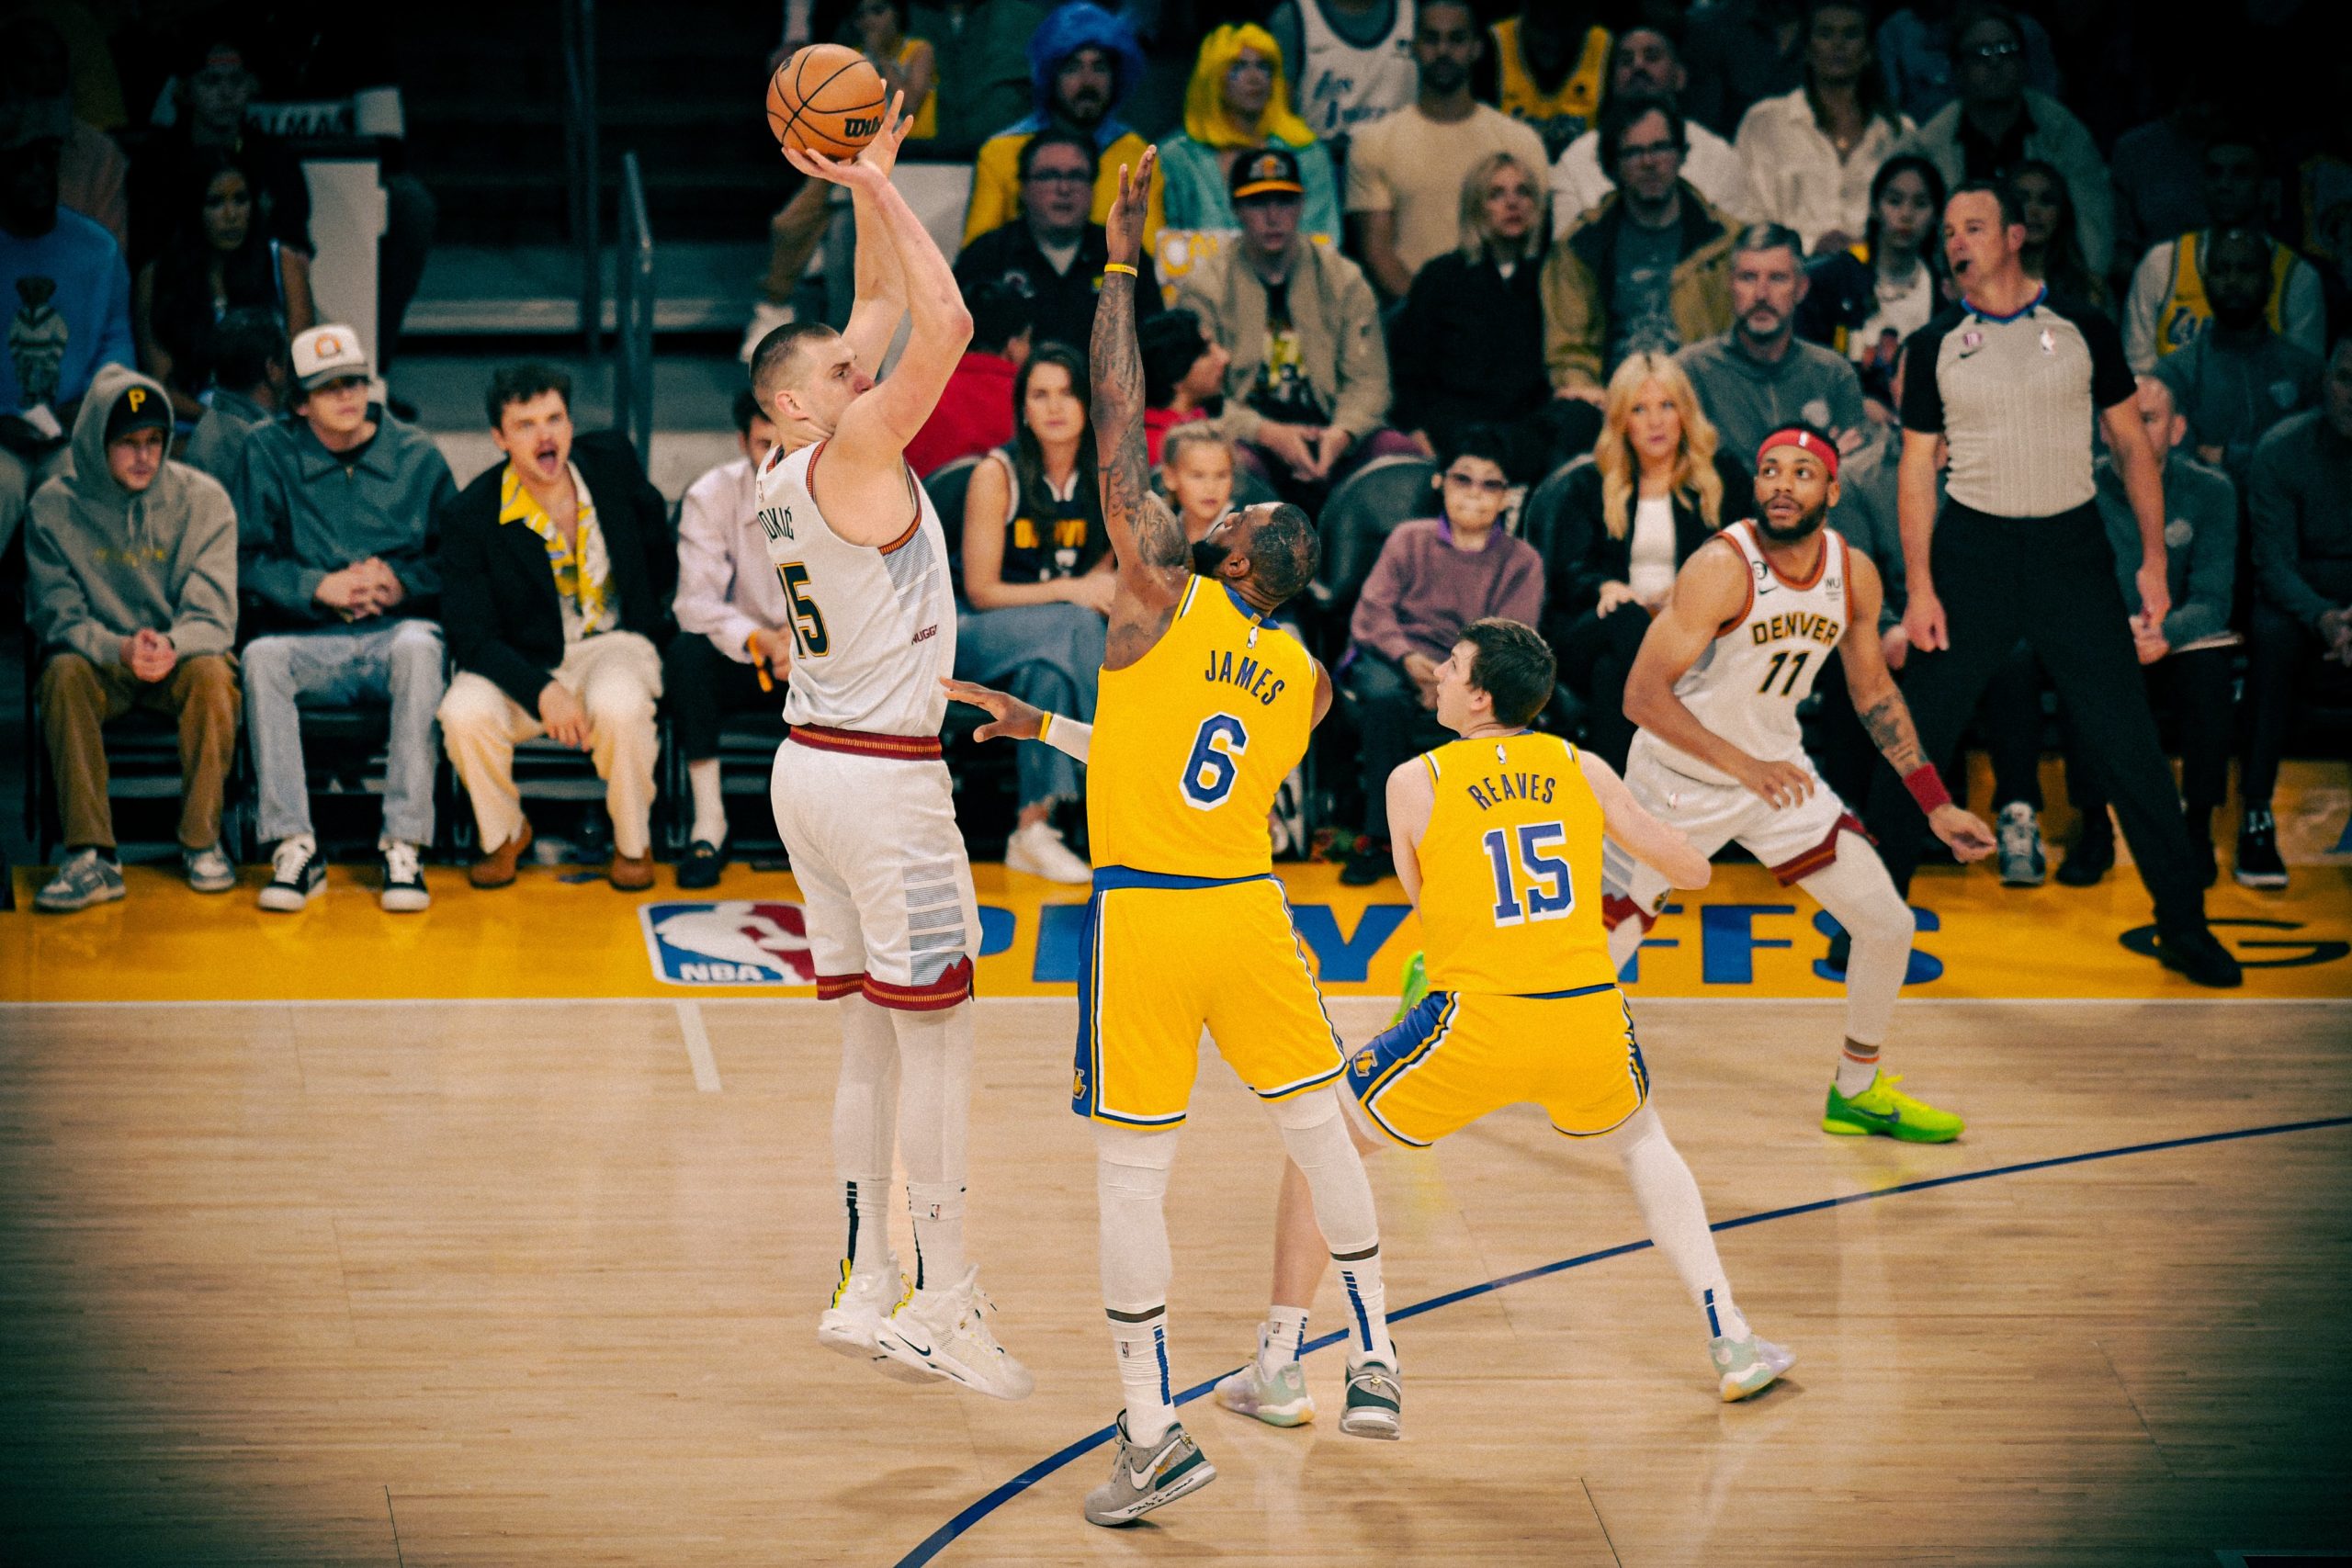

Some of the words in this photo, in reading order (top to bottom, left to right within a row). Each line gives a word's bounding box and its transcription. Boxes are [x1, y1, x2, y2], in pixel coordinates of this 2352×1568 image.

[128, 388, 147, 413] P
[757, 506, 794, 544] OKIĆ
[1750, 611, 1839, 647] DENVER
[1204, 649, 1284, 705] JAMES
[1757, 650, 1811, 696] 11
[1179, 711, 1250, 812] 6
[1466, 773, 1555, 811] REAVES
[1482, 820, 1576, 928] 15
[679, 962, 765, 982] NBA
